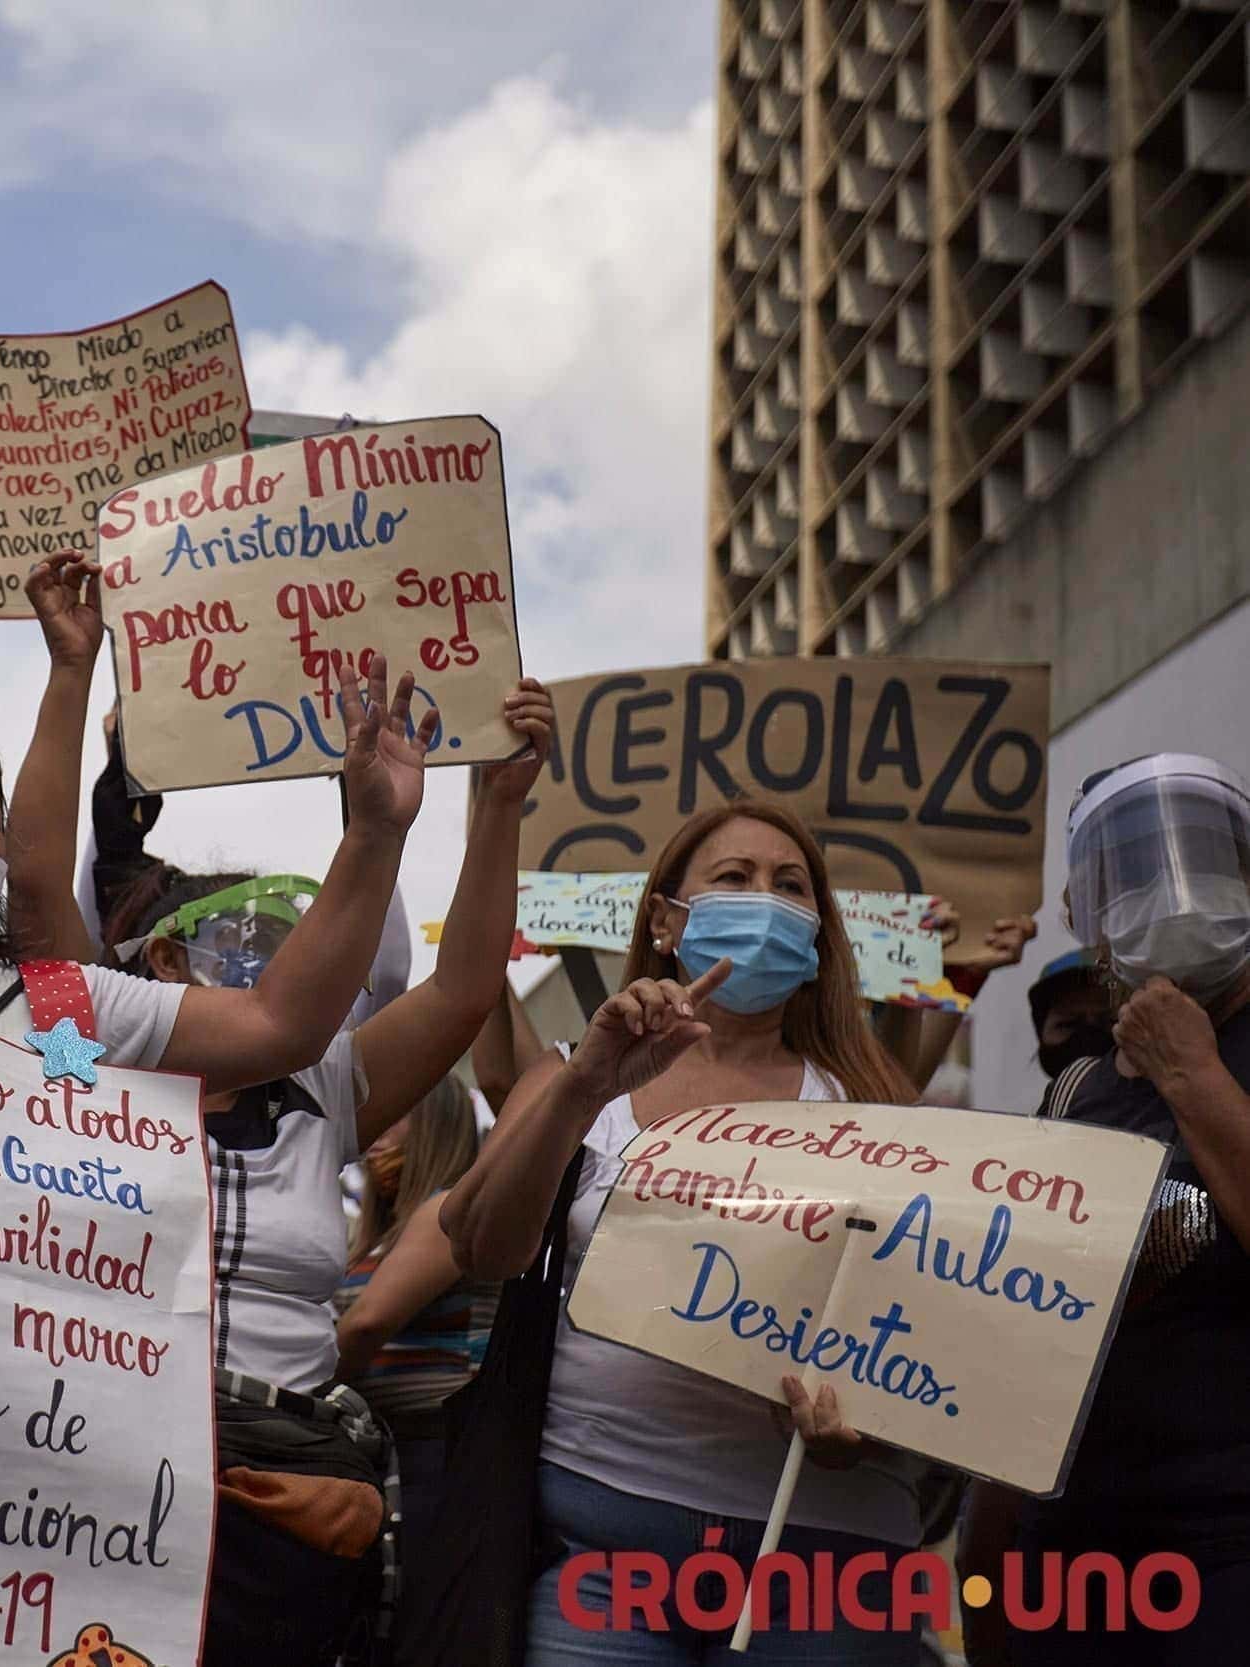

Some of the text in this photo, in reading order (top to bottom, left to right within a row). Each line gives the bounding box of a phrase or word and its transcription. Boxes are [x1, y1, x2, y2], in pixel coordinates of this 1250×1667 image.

[77, 323, 142, 366] Miedo
[164, 309, 185, 333] a
[38, 365, 114, 400] Director
[125, 366, 137, 384] o
[114, 388, 138, 419] Ni
[75, 463, 123, 495] me
[135, 449, 166, 478] da
[171, 420, 236, 464] Miedo
[119, 421, 146, 450] Ni
[98, 455, 285, 540] Sueldo
[103, 490, 409, 590] a Aristobulo
[122, 600, 248, 692] para
[276, 578, 367, 658] que
[181, 639, 246, 700] lo
[419, 634, 480, 672] es
[224, 685, 461, 770] DUO.
[2, 1135, 153, 1215] Gaceta
[619, 1140, 836, 1243] hambre
[647, 1106, 1090, 1225] Maestros con
[14, 1299, 169, 1377] marco
[670, 1242, 960, 1416] Desiertas.
[24, 1378, 89, 1455] de
